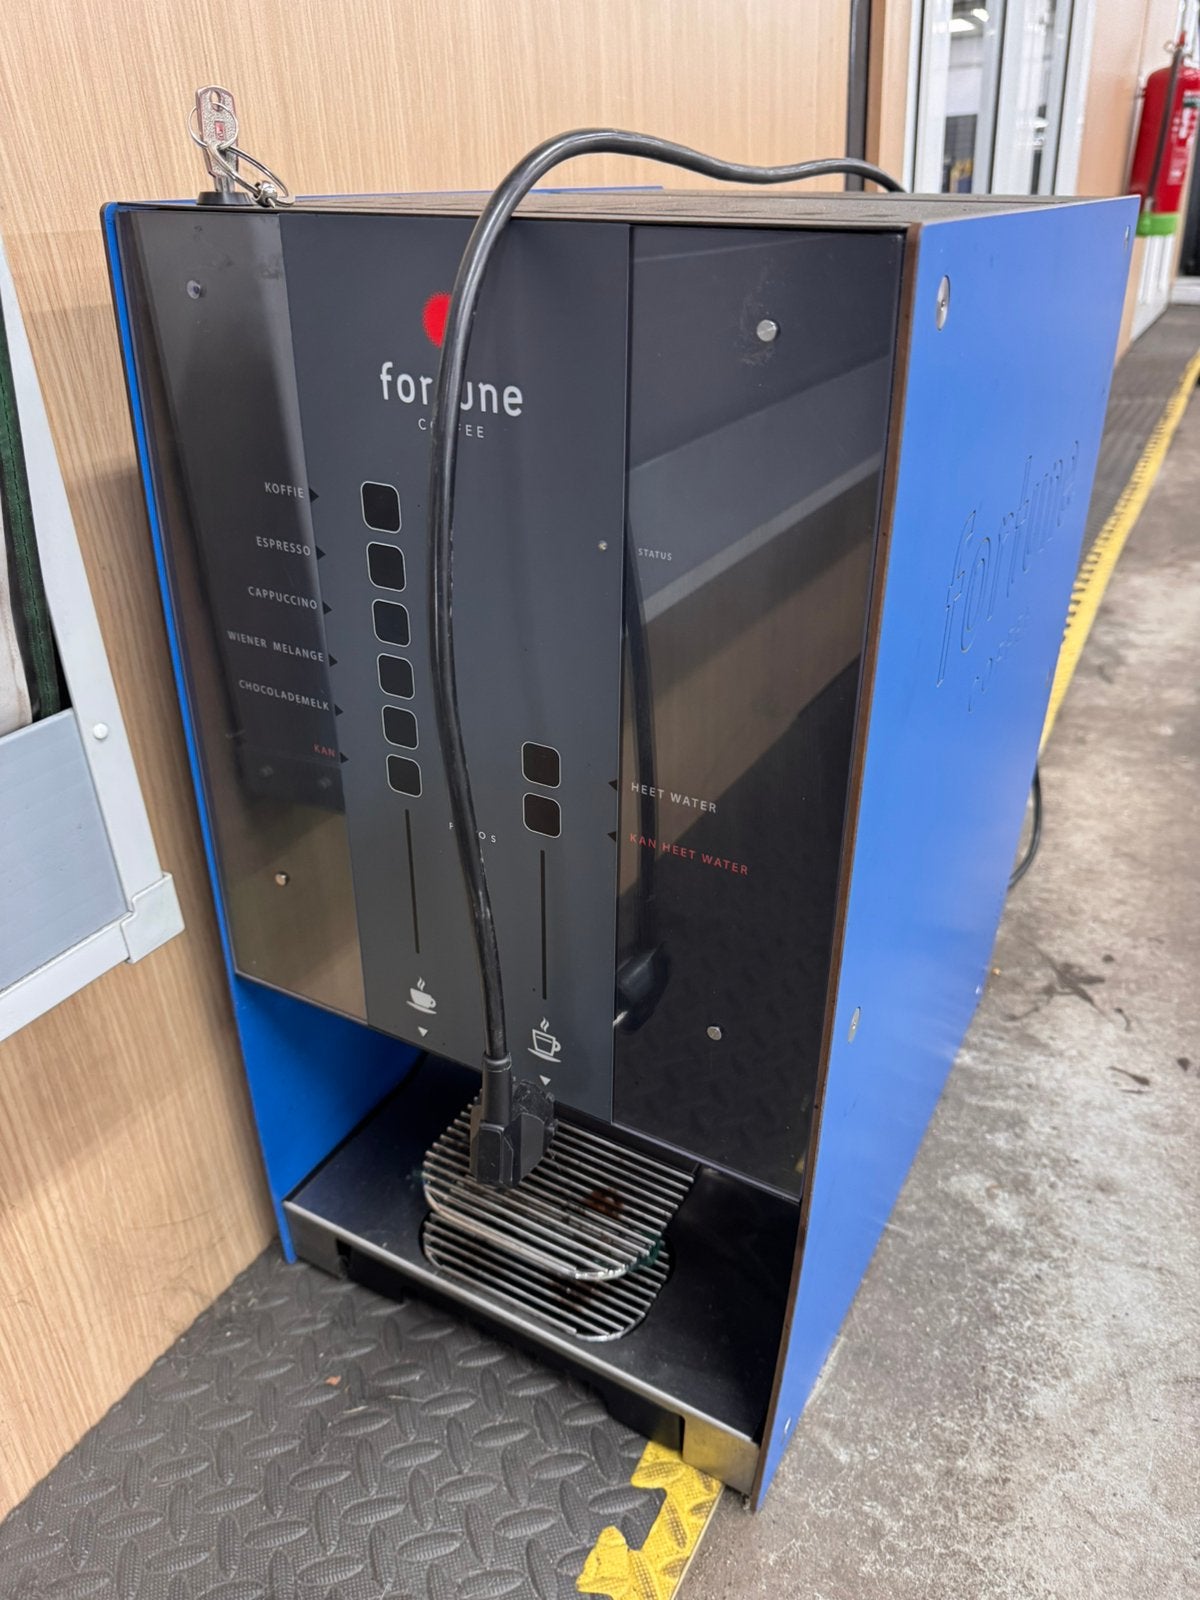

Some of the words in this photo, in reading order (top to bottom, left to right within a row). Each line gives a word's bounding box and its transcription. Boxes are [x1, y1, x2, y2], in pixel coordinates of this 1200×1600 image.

[380, 361, 523, 417] forune
[418, 418, 484, 438] CEE
[264, 482, 304, 499] KOFFIE
[255, 536, 311, 556] ESPRESSO
[638, 548, 673, 561] STATUS
[248, 586, 318, 610] CAPPUCCINO
[227, 630, 267, 648] WIENER
[273, 641, 324, 662] MELANGE
[238, 679, 330, 711] CHOCOLADEMELK
[313, 743, 336, 757] KAN
[631, 782, 665, 799] HEET
[670, 791, 717, 813] WATER
[629, 833, 657, 849] KAN
[661, 842, 696, 860] HEET
[701, 852, 748, 875] WATER
